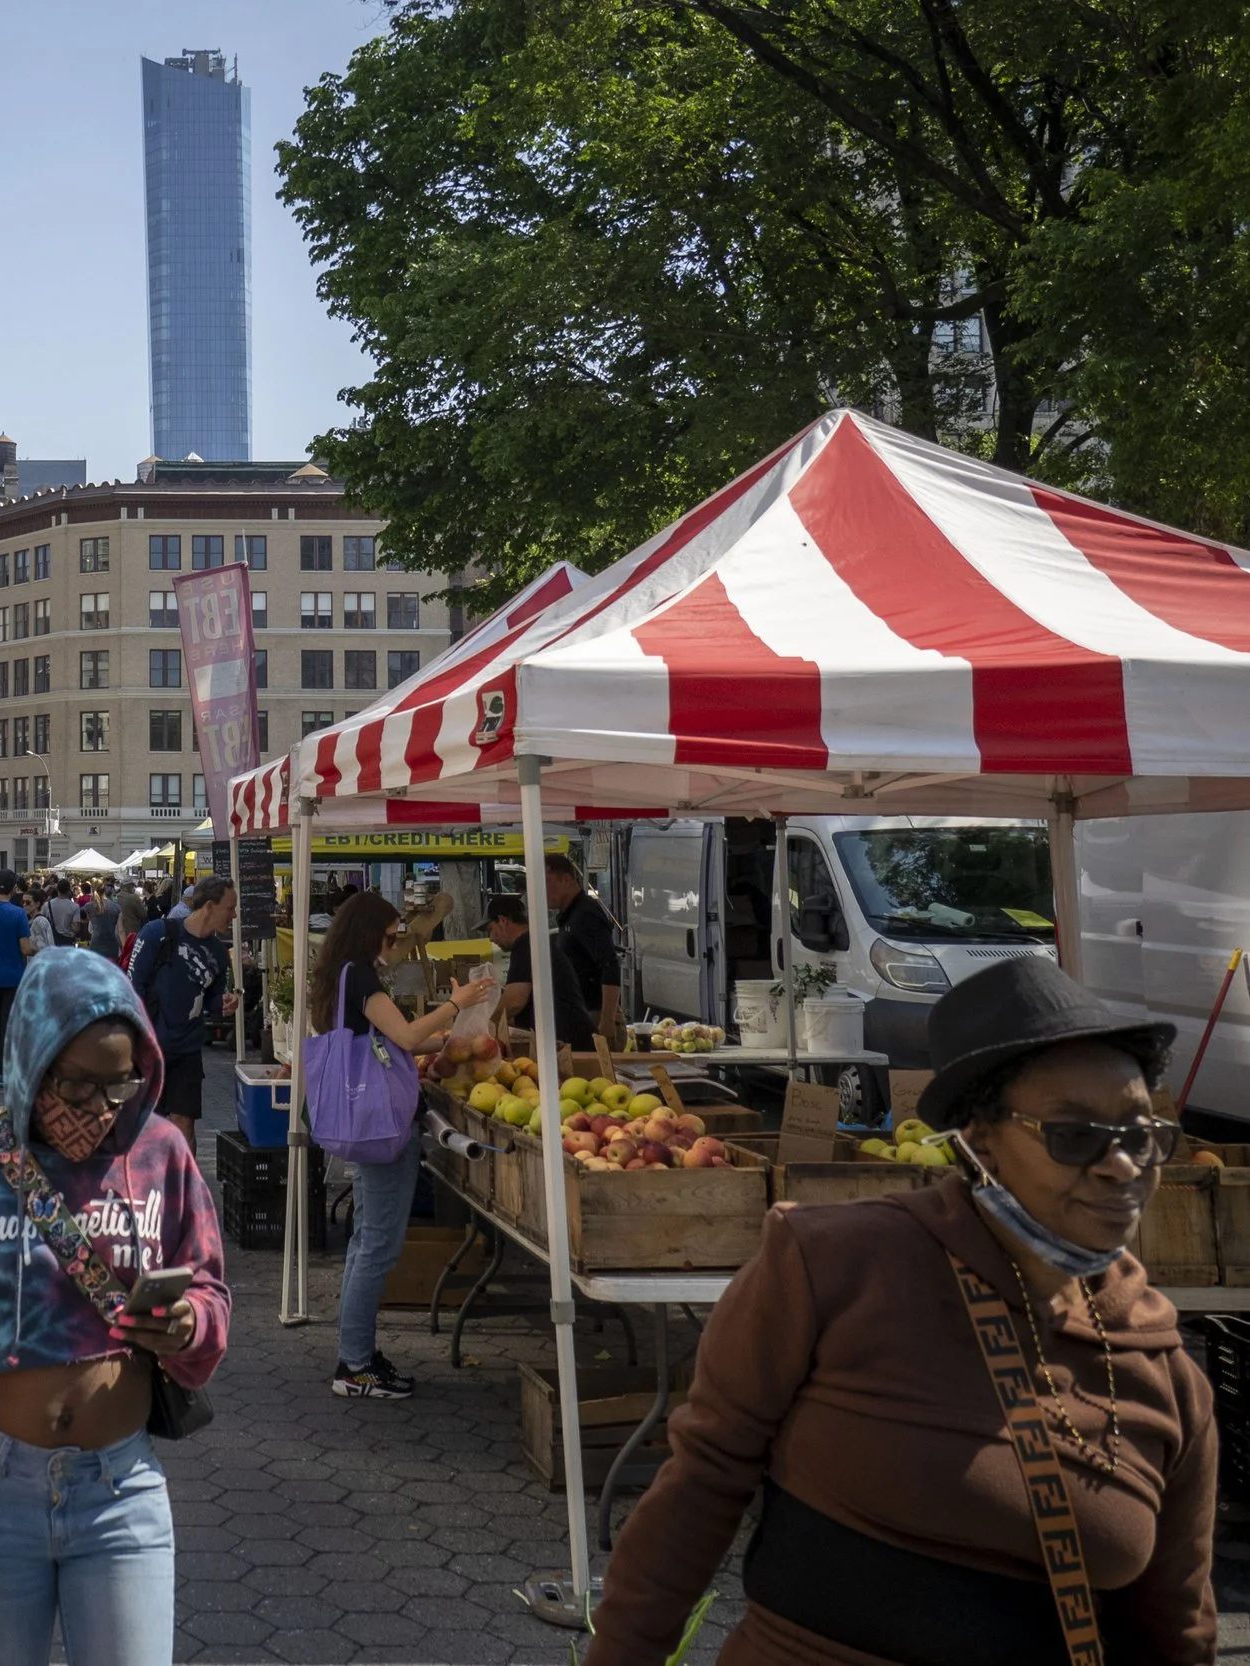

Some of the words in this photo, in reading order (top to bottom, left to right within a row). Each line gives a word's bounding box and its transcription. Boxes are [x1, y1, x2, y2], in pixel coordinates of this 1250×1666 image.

[324, 832, 441, 846] EBT/CREDIT
[451, 832, 506, 846] HERE
[113, 1243, 152, 1271] me
